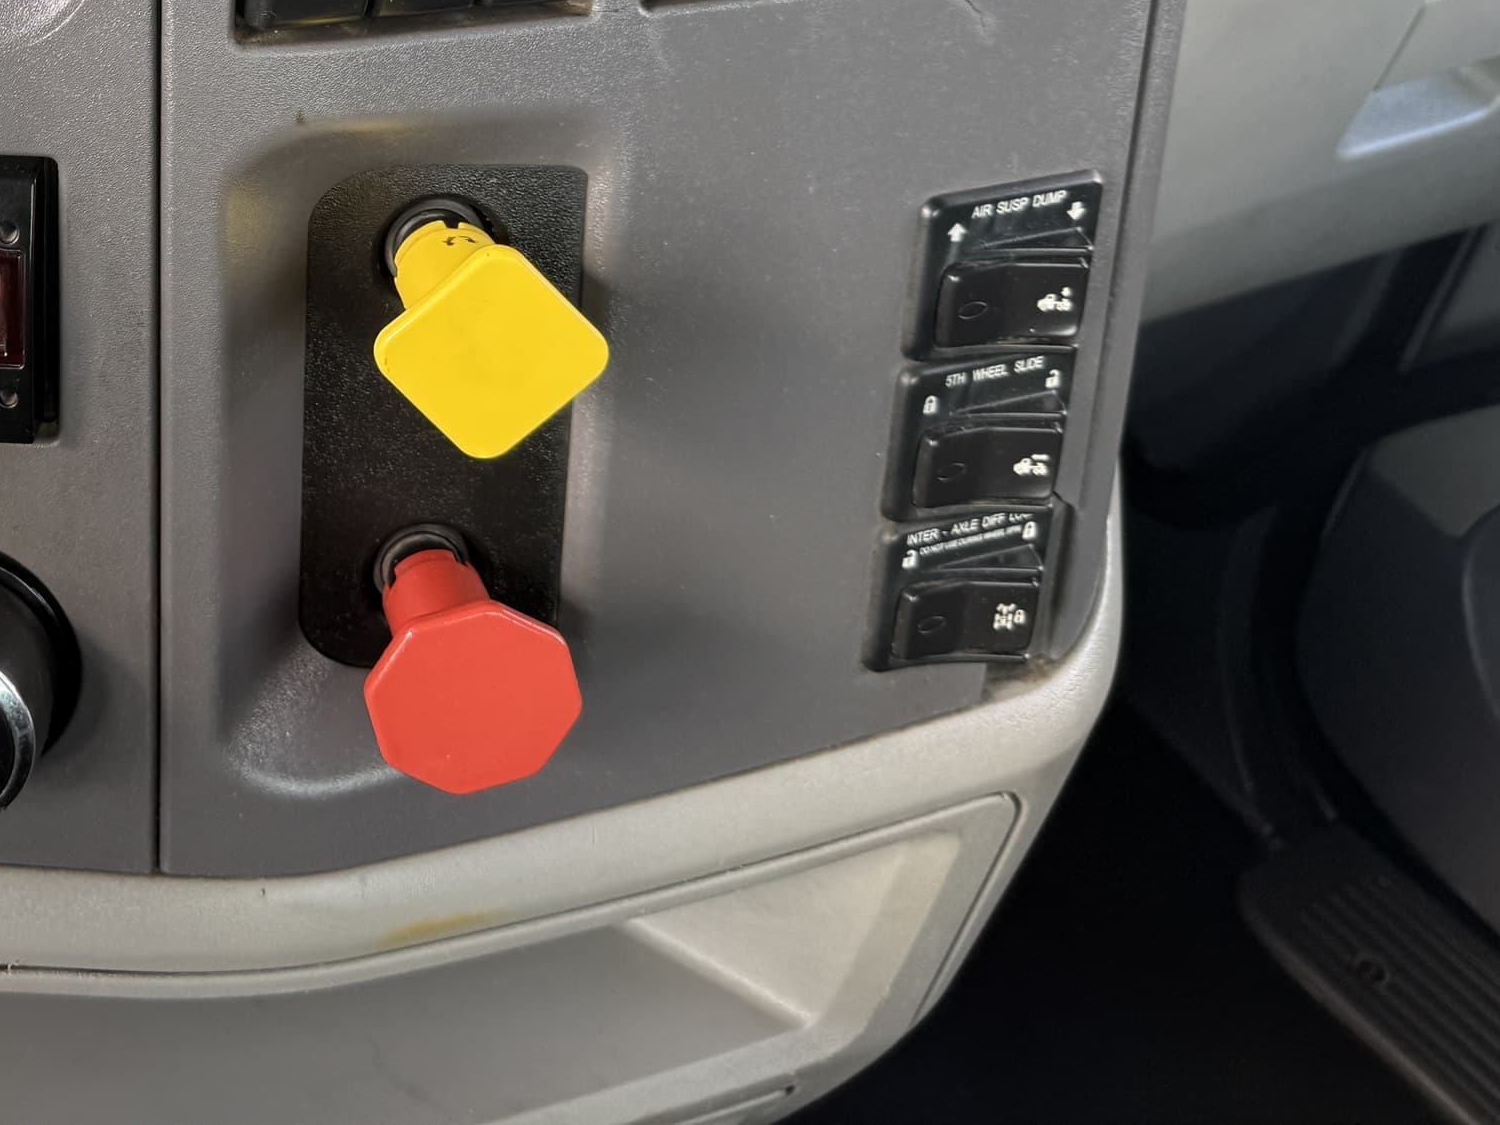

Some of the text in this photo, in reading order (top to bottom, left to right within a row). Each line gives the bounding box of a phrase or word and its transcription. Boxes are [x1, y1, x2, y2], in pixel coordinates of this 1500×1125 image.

[971, 190, 1068, 219] AIR SUSP DUMP
[945, 355, 1045, 388] 5TH WHEEL SLIDE
[906, 528, 940, 546] INTER
[950, 518, 980, 535] AXLE
[982, 512, 1006, 529] DIFF
